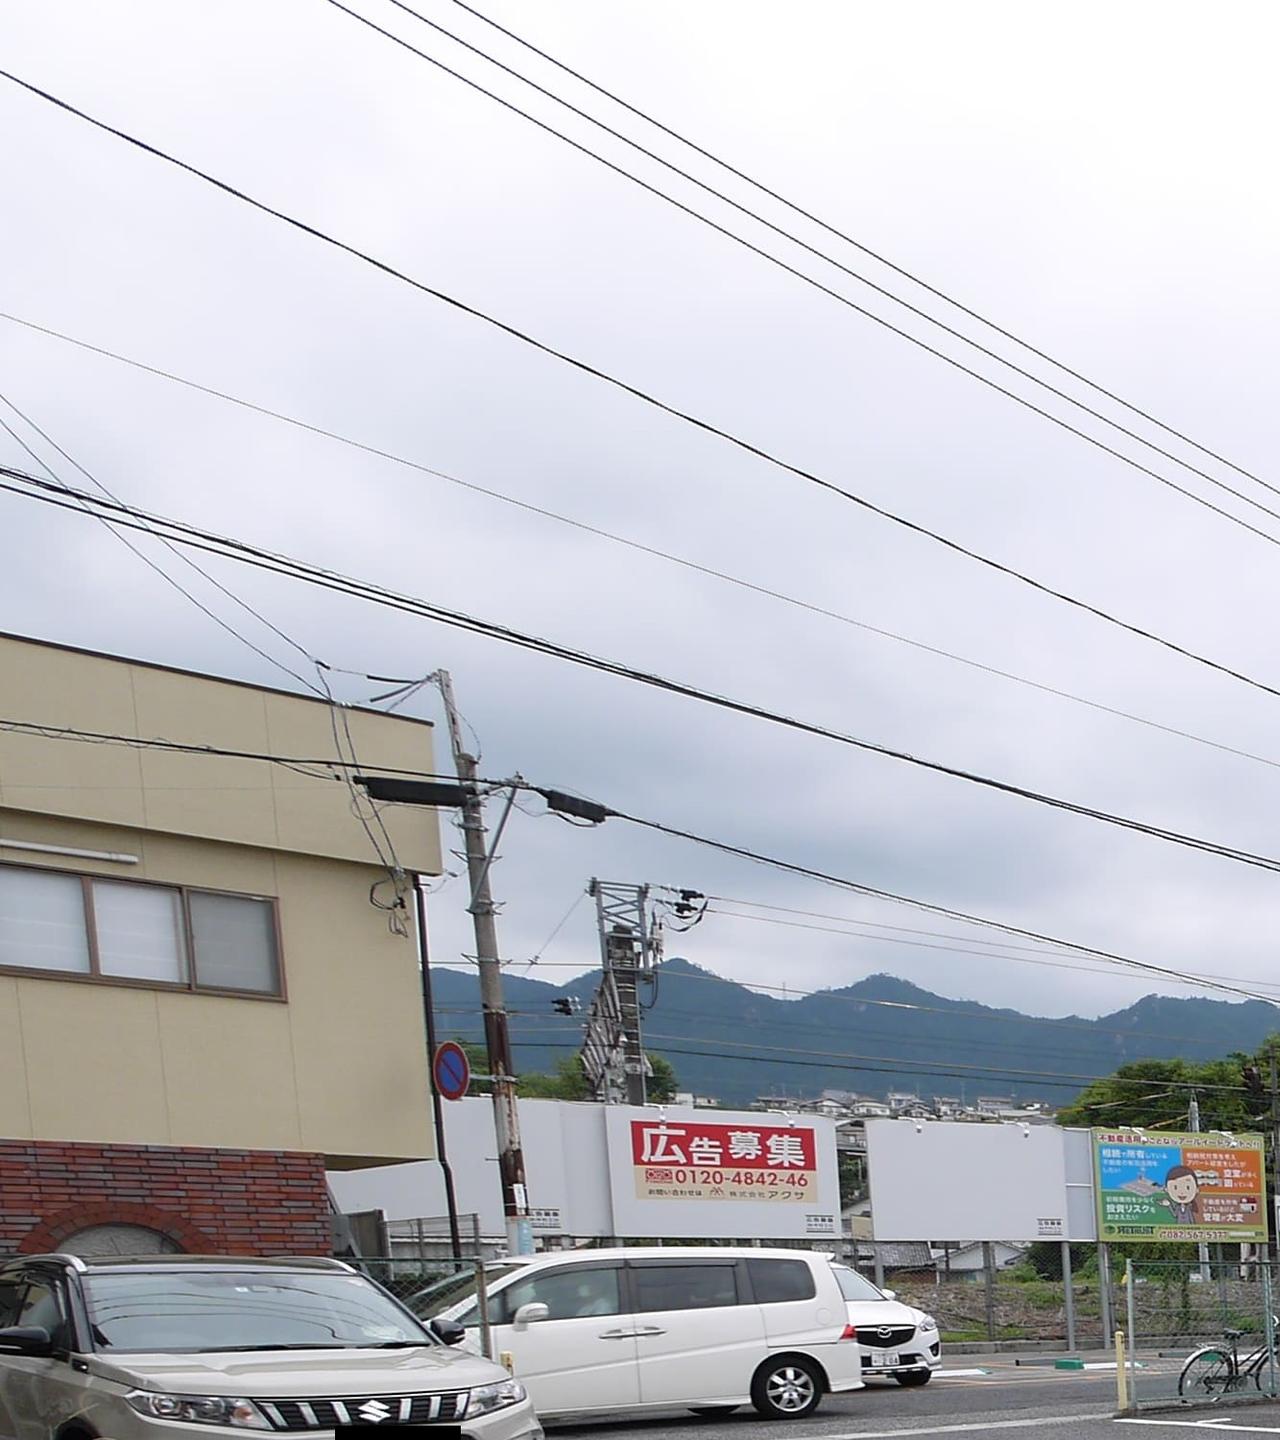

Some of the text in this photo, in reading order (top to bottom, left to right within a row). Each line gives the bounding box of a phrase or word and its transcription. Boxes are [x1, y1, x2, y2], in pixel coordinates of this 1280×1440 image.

[641, 1125, 805, 1167] 広告募集
[675, 1169, 808, 1187] 0120-4842-46
[648, 1188, 702, 1197] お問い合わせは
